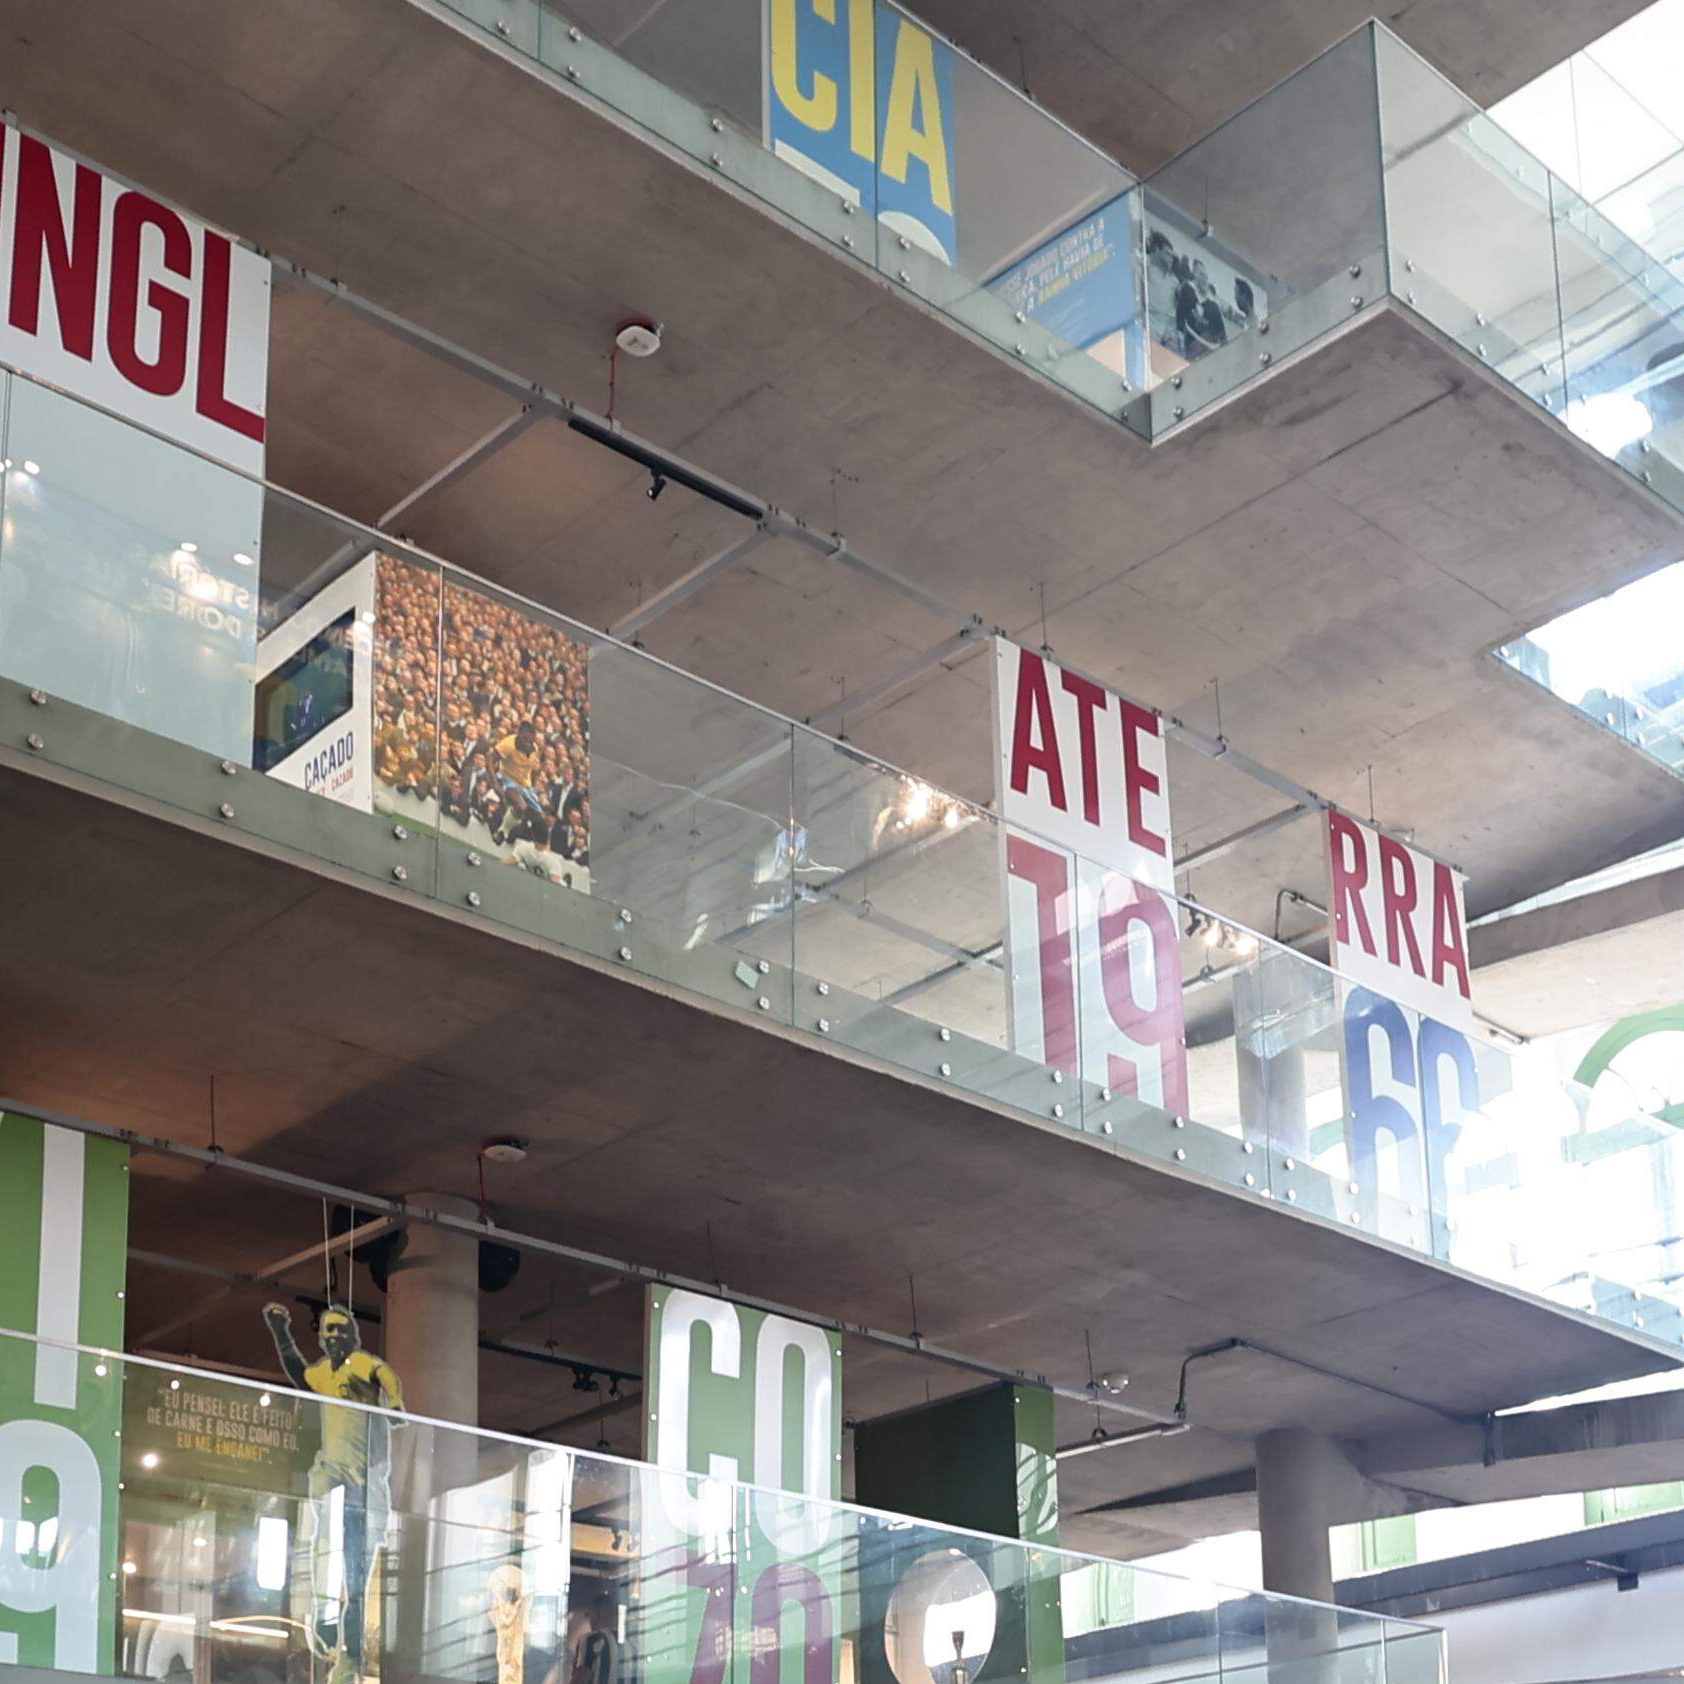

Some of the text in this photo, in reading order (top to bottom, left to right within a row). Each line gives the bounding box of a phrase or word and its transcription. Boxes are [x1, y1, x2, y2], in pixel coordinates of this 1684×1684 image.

[771, 0, 953, 216] CIA
[304, 731, 354, 790] CAÇADO
[1010, 647, 1167, 858] ATE
[1006, 833, 1189, 1120] 19
[1328, 809, 1472, 1000] RRA
[147, 1407, 162, 1425] DE
[166, 1410, 203, 1433] CARNE
[248, 1426, 280, 1447] COMO
[656, 1287, 833, 1554] CO
